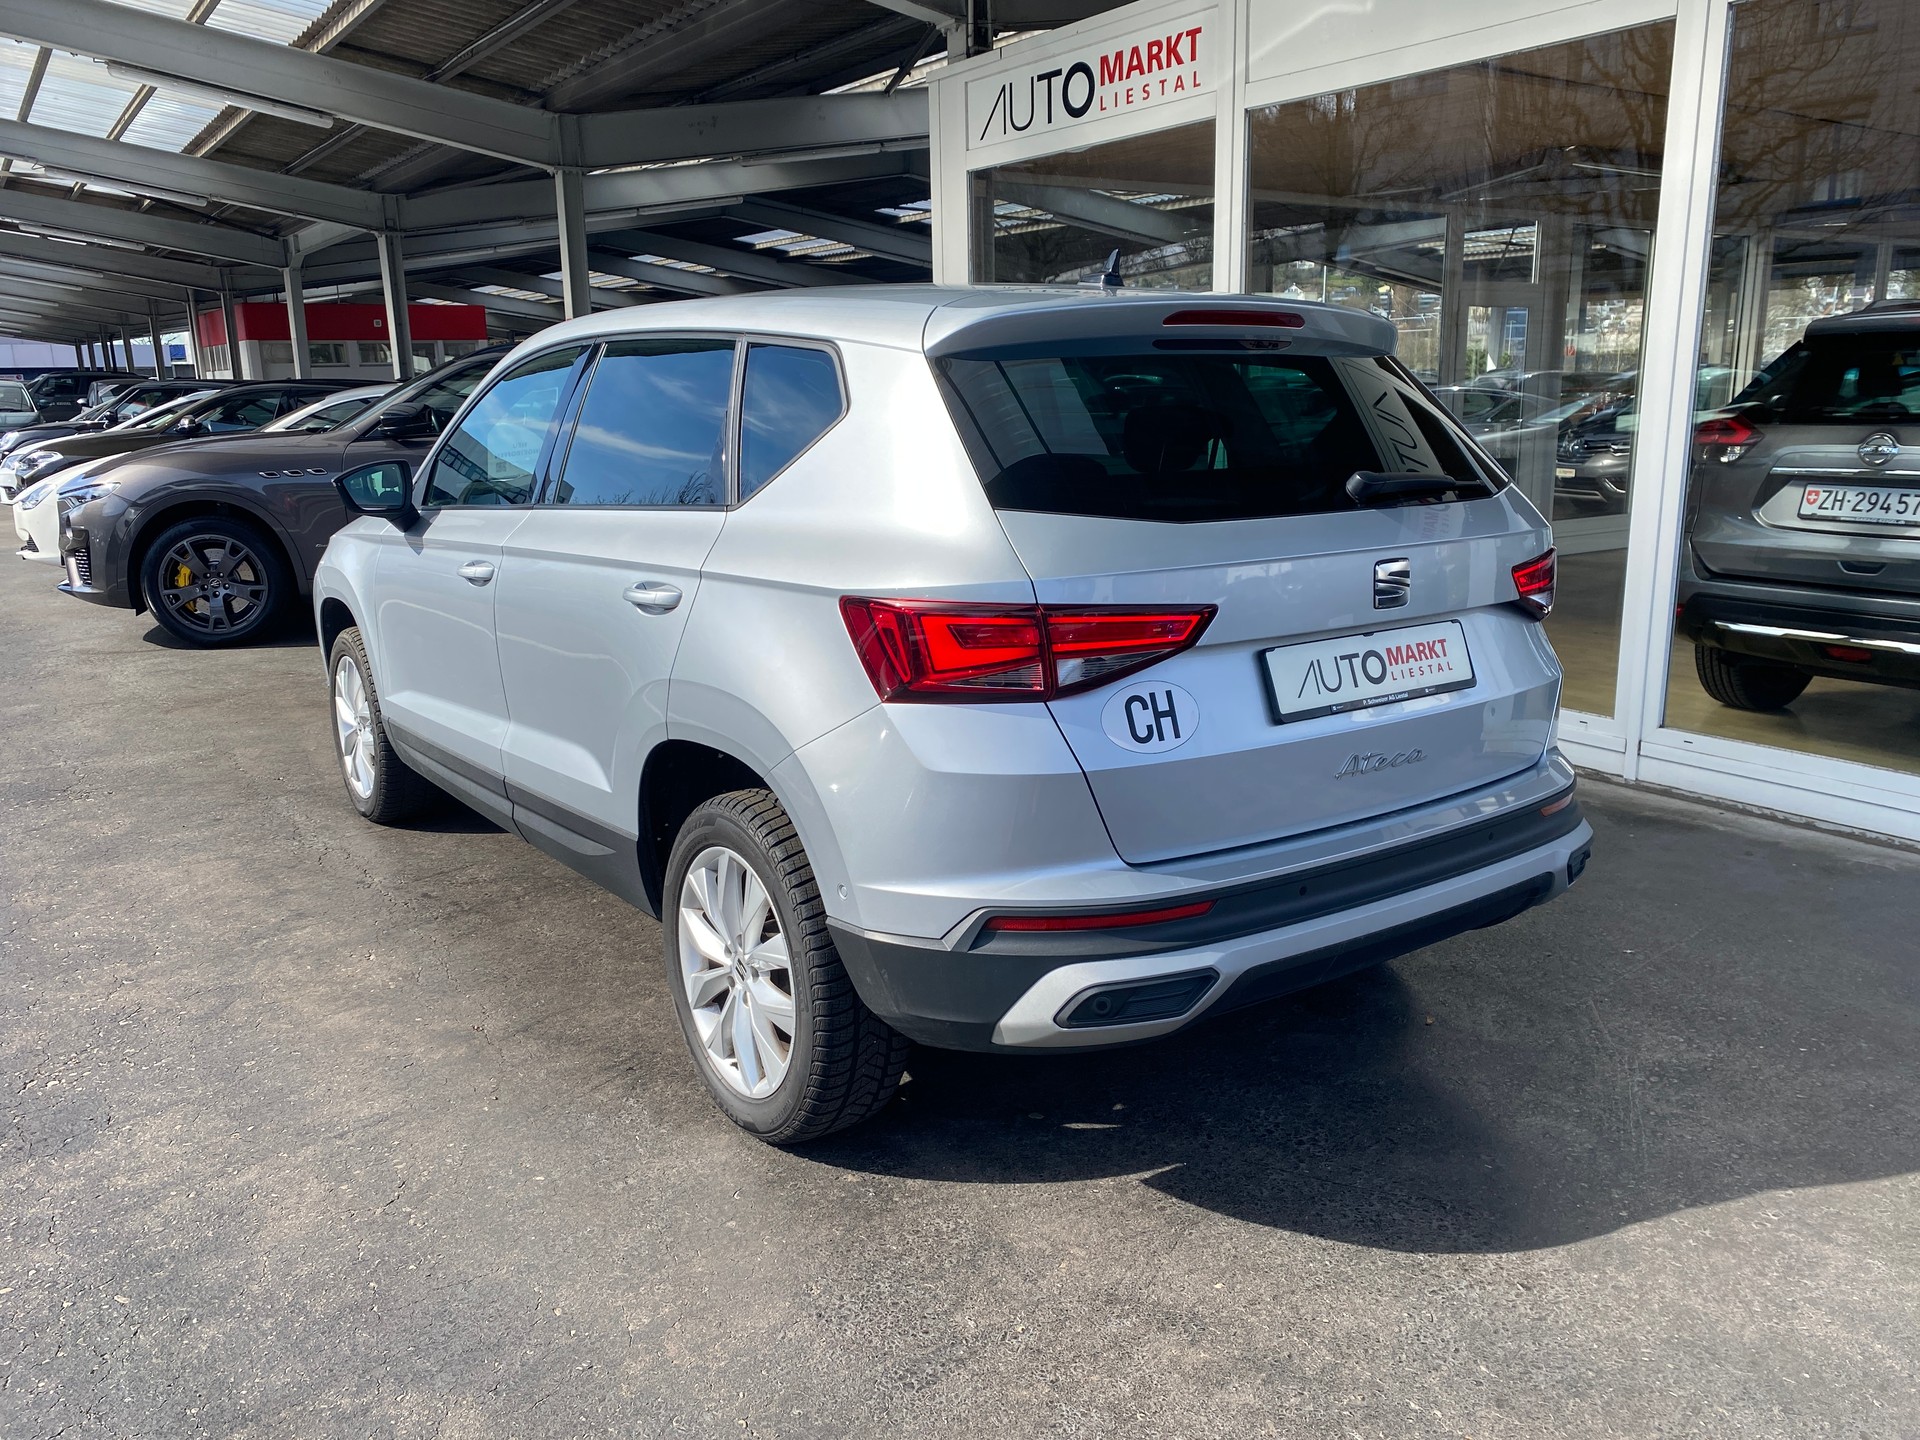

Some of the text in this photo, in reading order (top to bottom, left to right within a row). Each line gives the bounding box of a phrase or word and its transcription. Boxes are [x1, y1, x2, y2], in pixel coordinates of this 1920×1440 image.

[980, 26, 1202, 141] AUTO MARKT
[1100, 70, 1202, 112] LIESTAL
[1298, 638, 1447, 699] AUTO MARKT
[1391, 661, 1454, 681] LIESTAL
[1124, 689, 1181, 744] CH
[1334, 747, 1427, 781] Ateca
